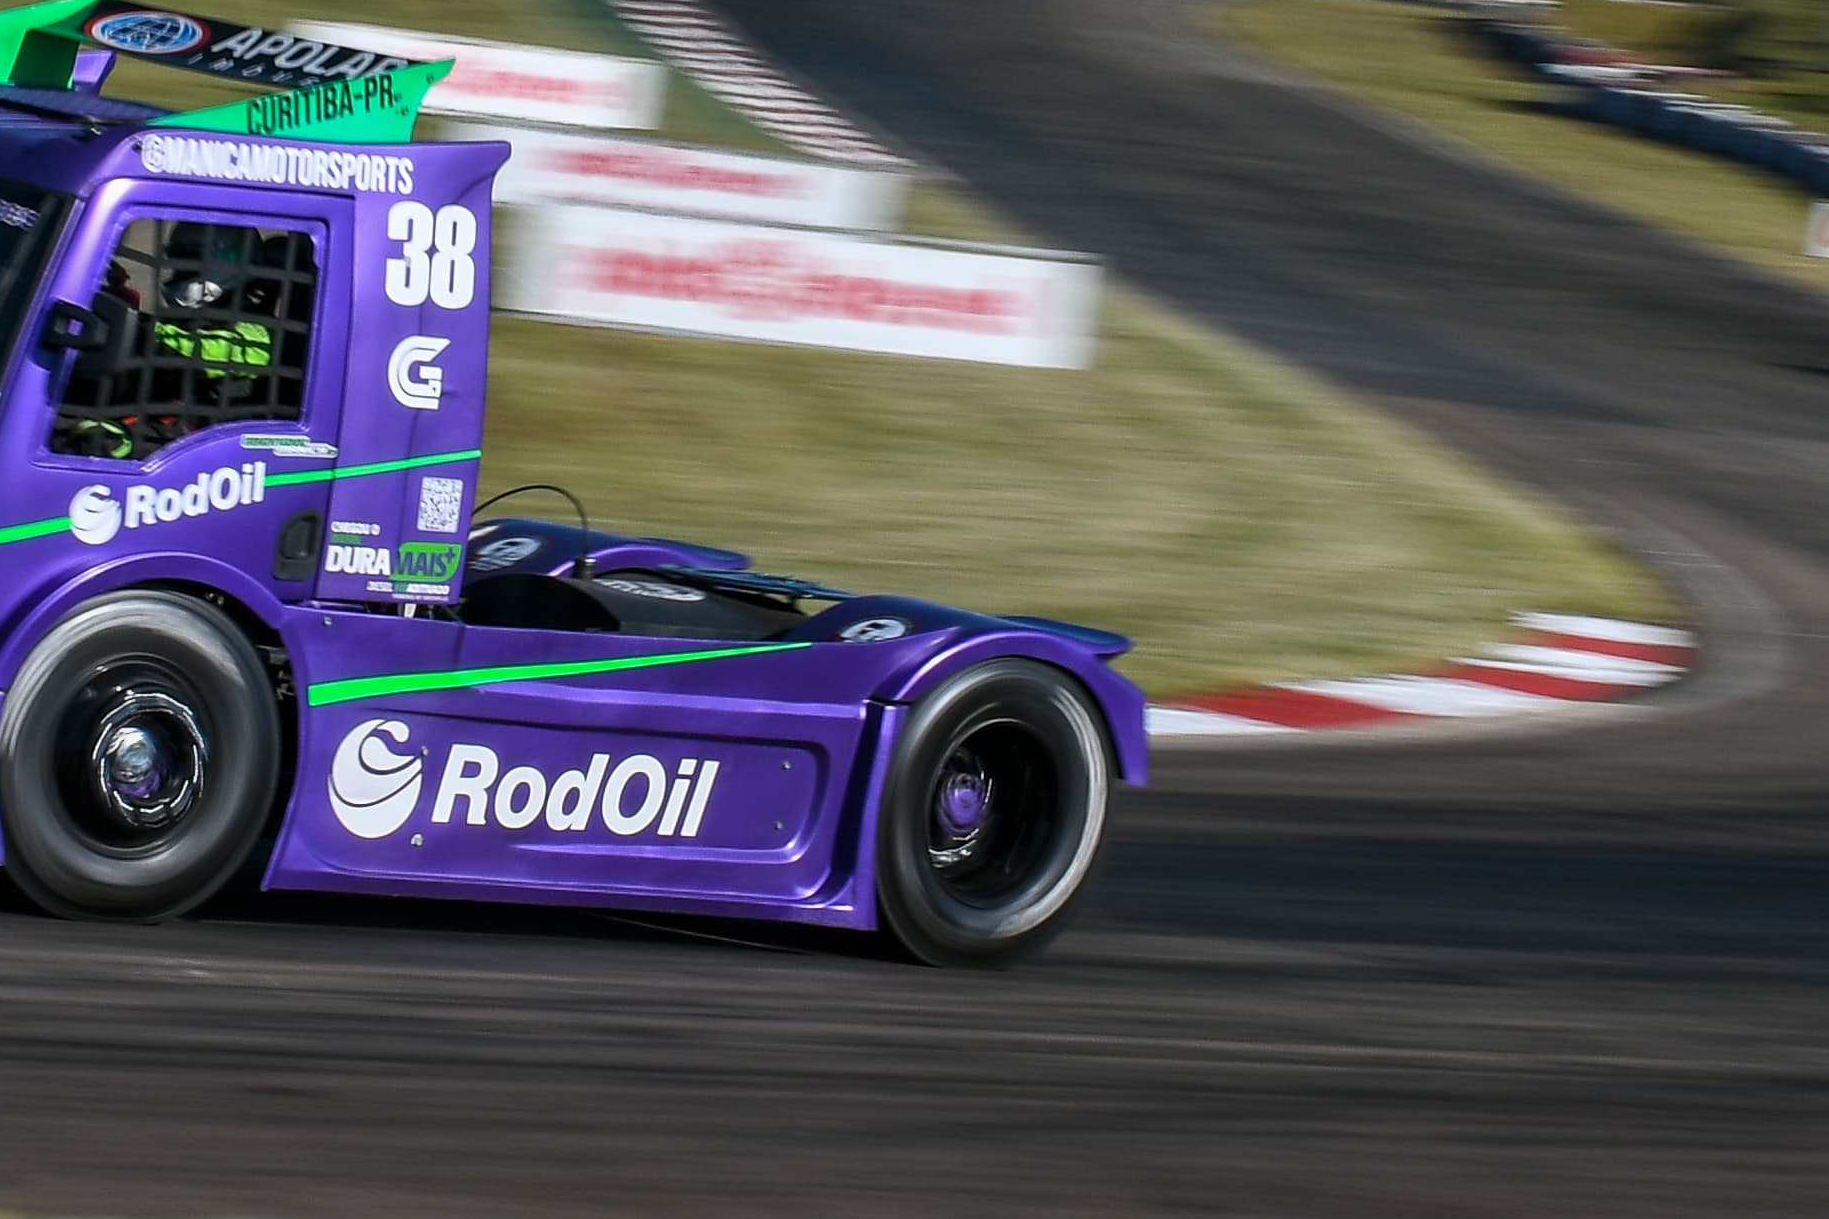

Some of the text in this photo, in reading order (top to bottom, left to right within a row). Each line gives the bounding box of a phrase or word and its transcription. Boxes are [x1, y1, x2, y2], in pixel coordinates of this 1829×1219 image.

[246, 73, 394, 135] CURITIBA-PR
[140, 133, 415, 194] @MANICAMOTORSPORTS
[385, 201, 477, 310] 38
[123, 460, 267, 530] RodOil
[430, 742, 720, 838] RodOil
